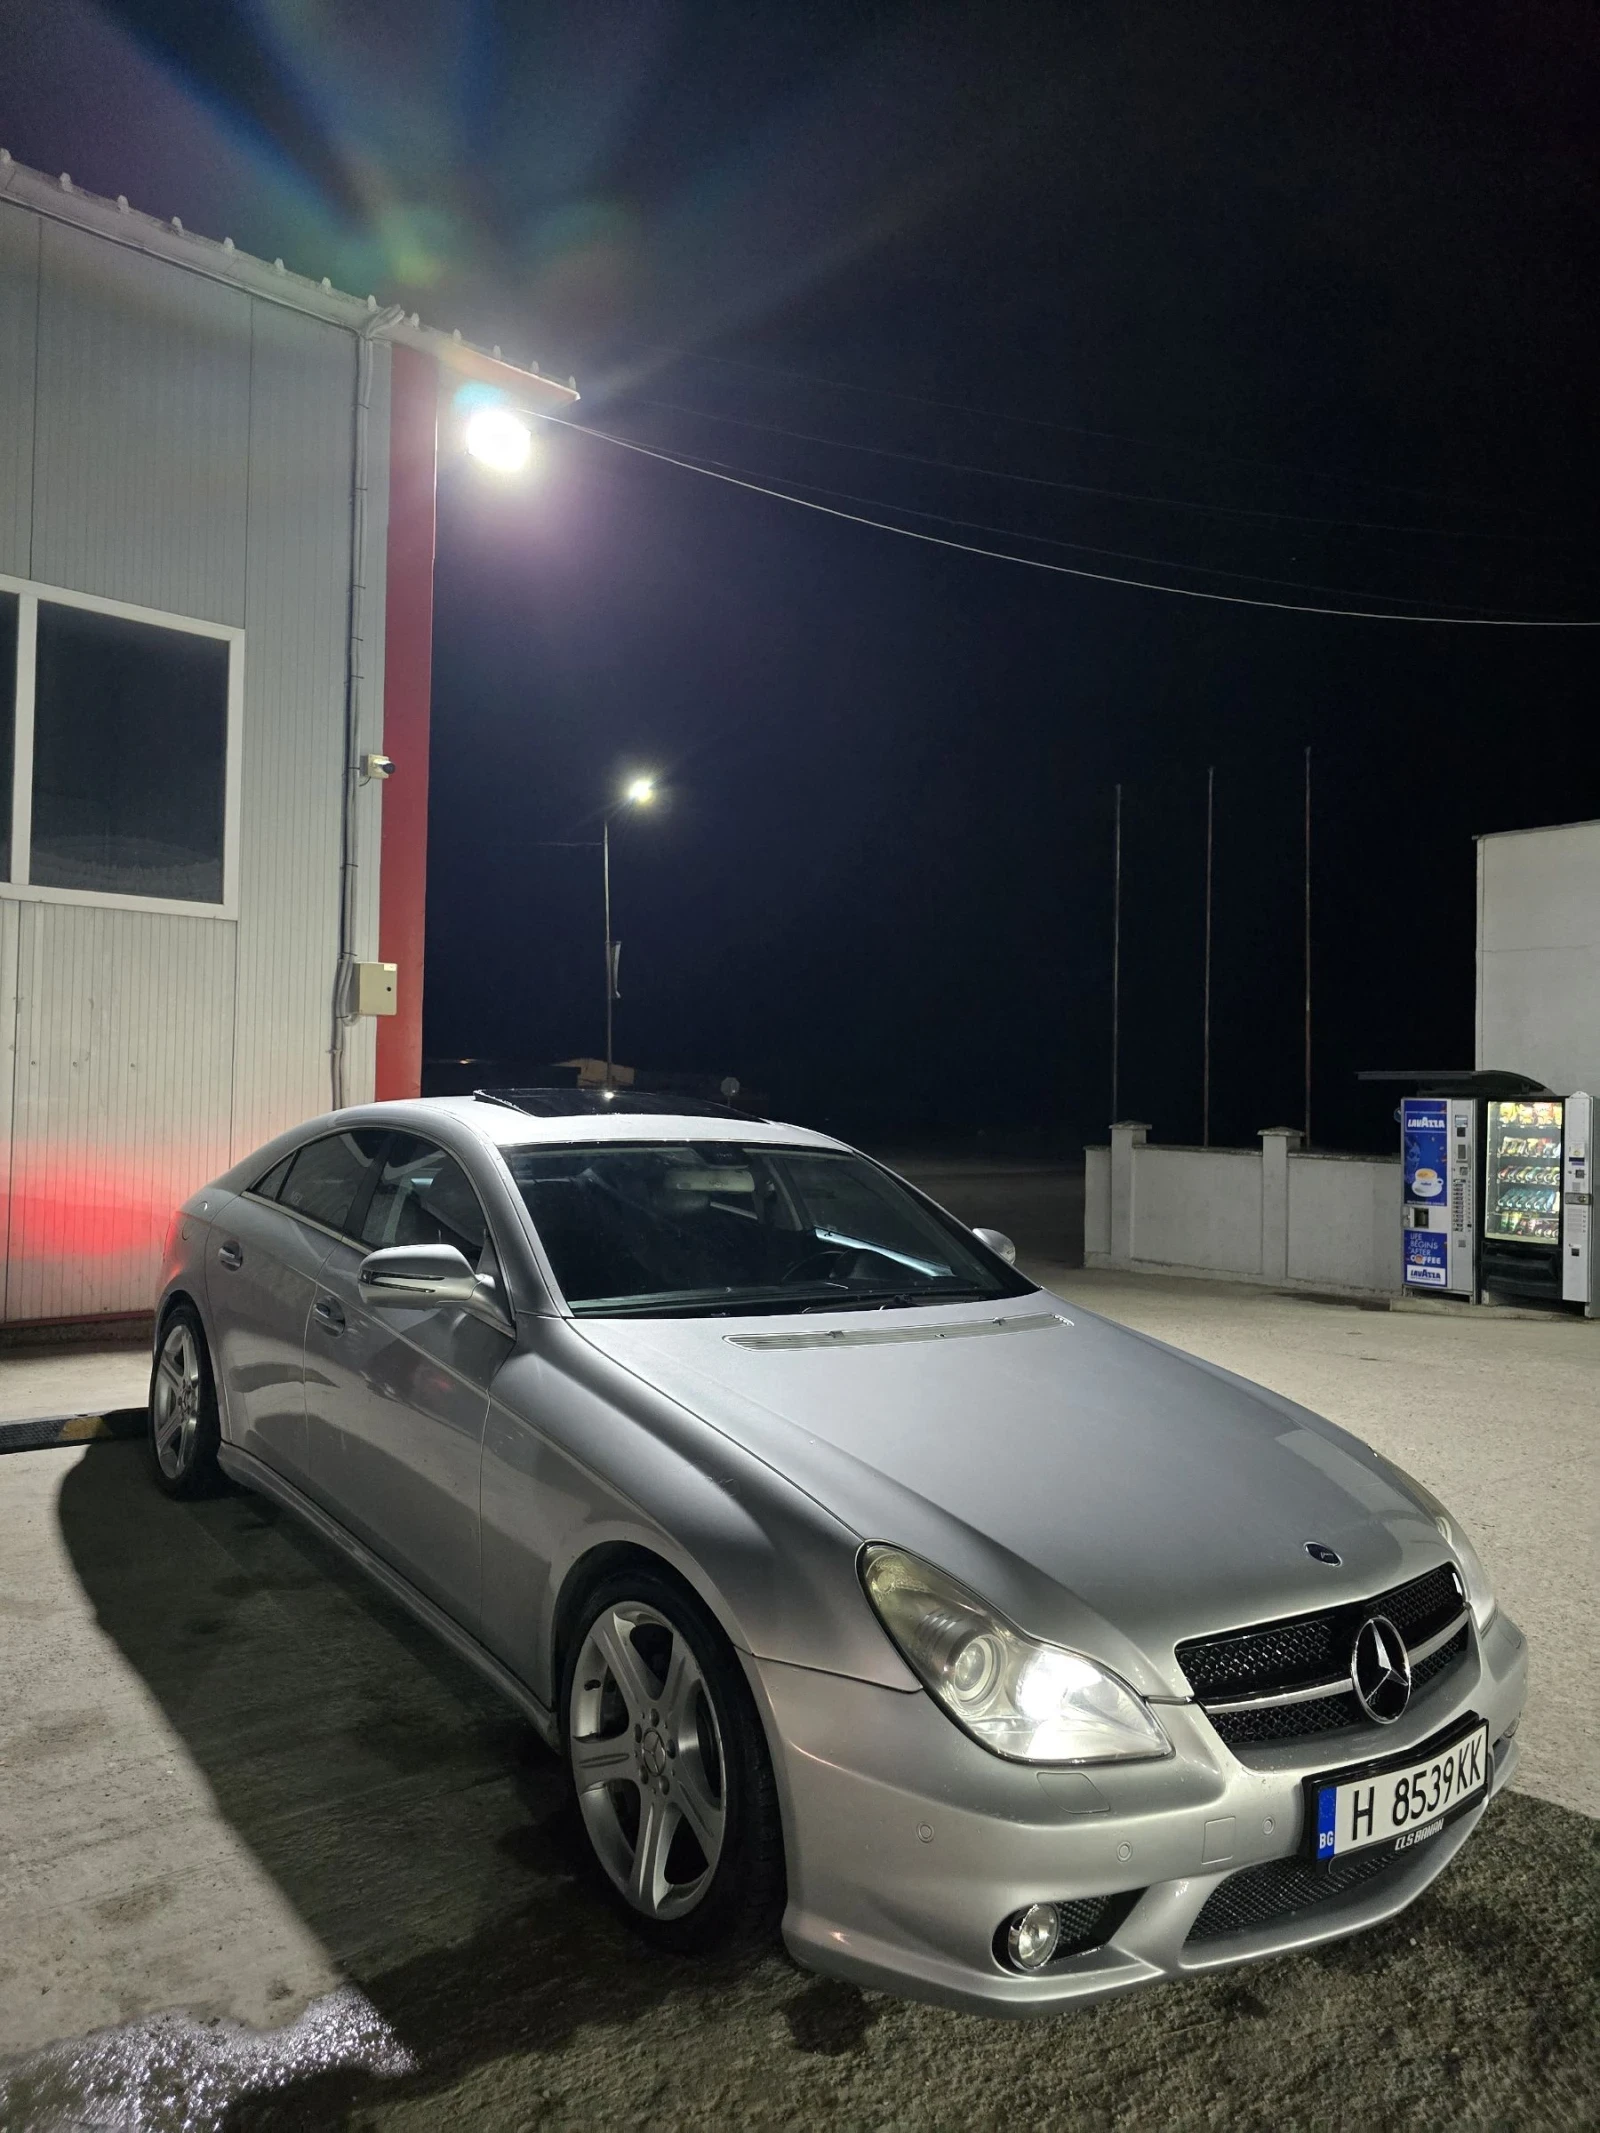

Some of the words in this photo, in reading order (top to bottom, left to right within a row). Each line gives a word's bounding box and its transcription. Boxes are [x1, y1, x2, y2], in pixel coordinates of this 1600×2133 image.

[1407, 1116, 1445, 1128] LAVAZZA
[1410, 1233, 1423, 1241] LIFE
[1410, 1240, 1438, 1250] BEGINS
[1410, 1247, 1431, 1256] AFTER
[1410, 1254, 1441, 1265] COFFEE
[1410, 1269, 1441, 1279] LAVAZZA
[1352, 1786, 1375, 1841] H
[1392, 1735, 1483, 1826] 8539KK
[1319, 1831, 1334, 1849] BG
[1394, 1832, 1415, 1851] CLS
